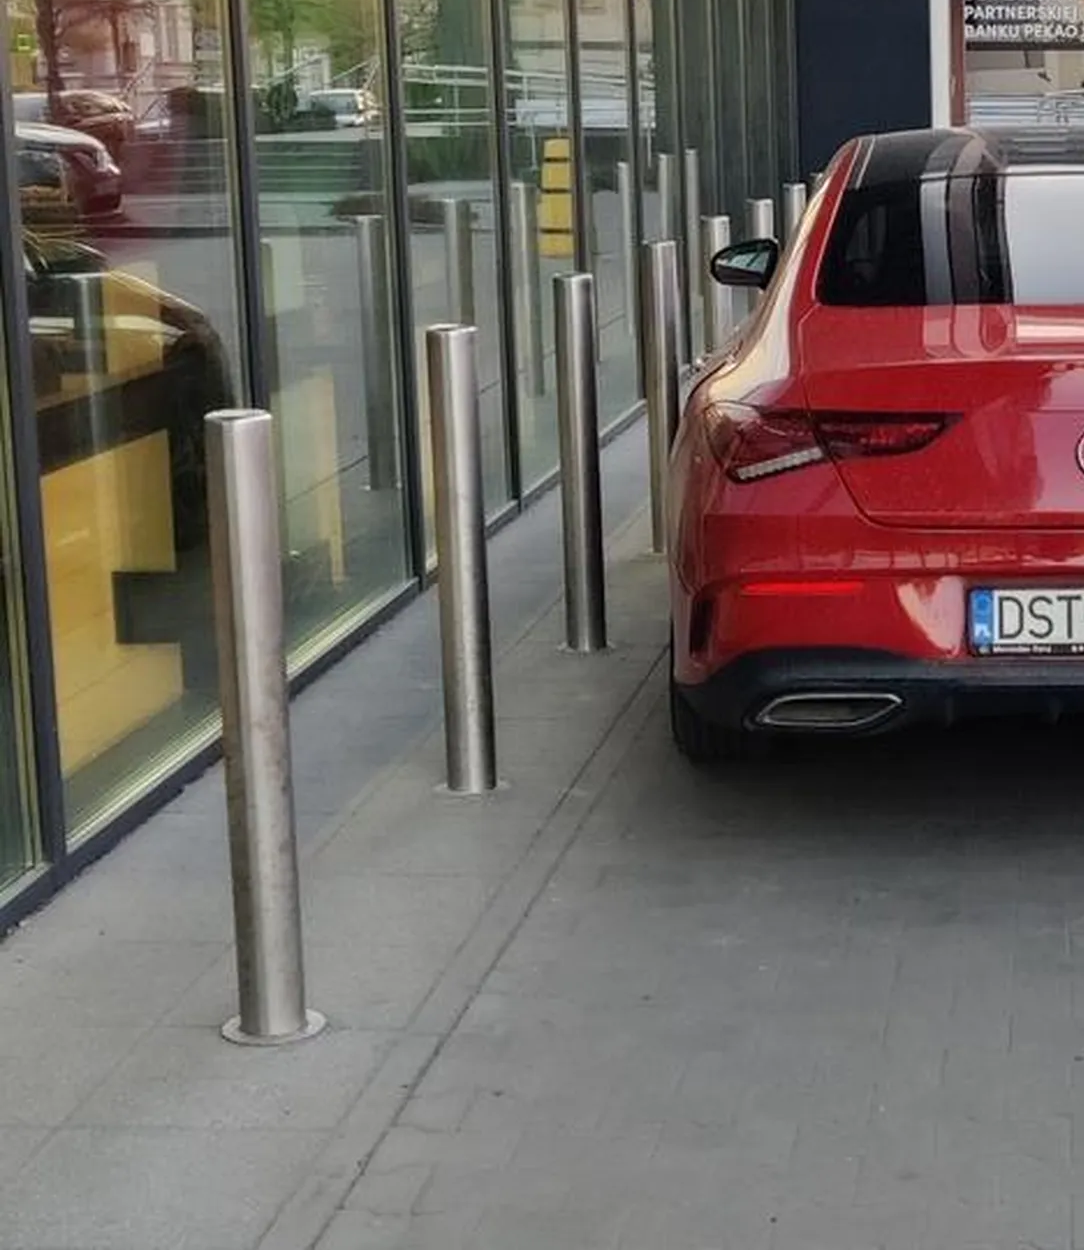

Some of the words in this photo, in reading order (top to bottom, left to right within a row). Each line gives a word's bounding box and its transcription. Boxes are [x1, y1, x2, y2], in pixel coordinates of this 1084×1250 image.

[964, 5, 1077, 23] PARTNERSKIEJ
[964, 23, 1020, 39] BANKU
[1024, 23, 1077, 39] PEKAO
[999, 594, 1082, 639] DST
